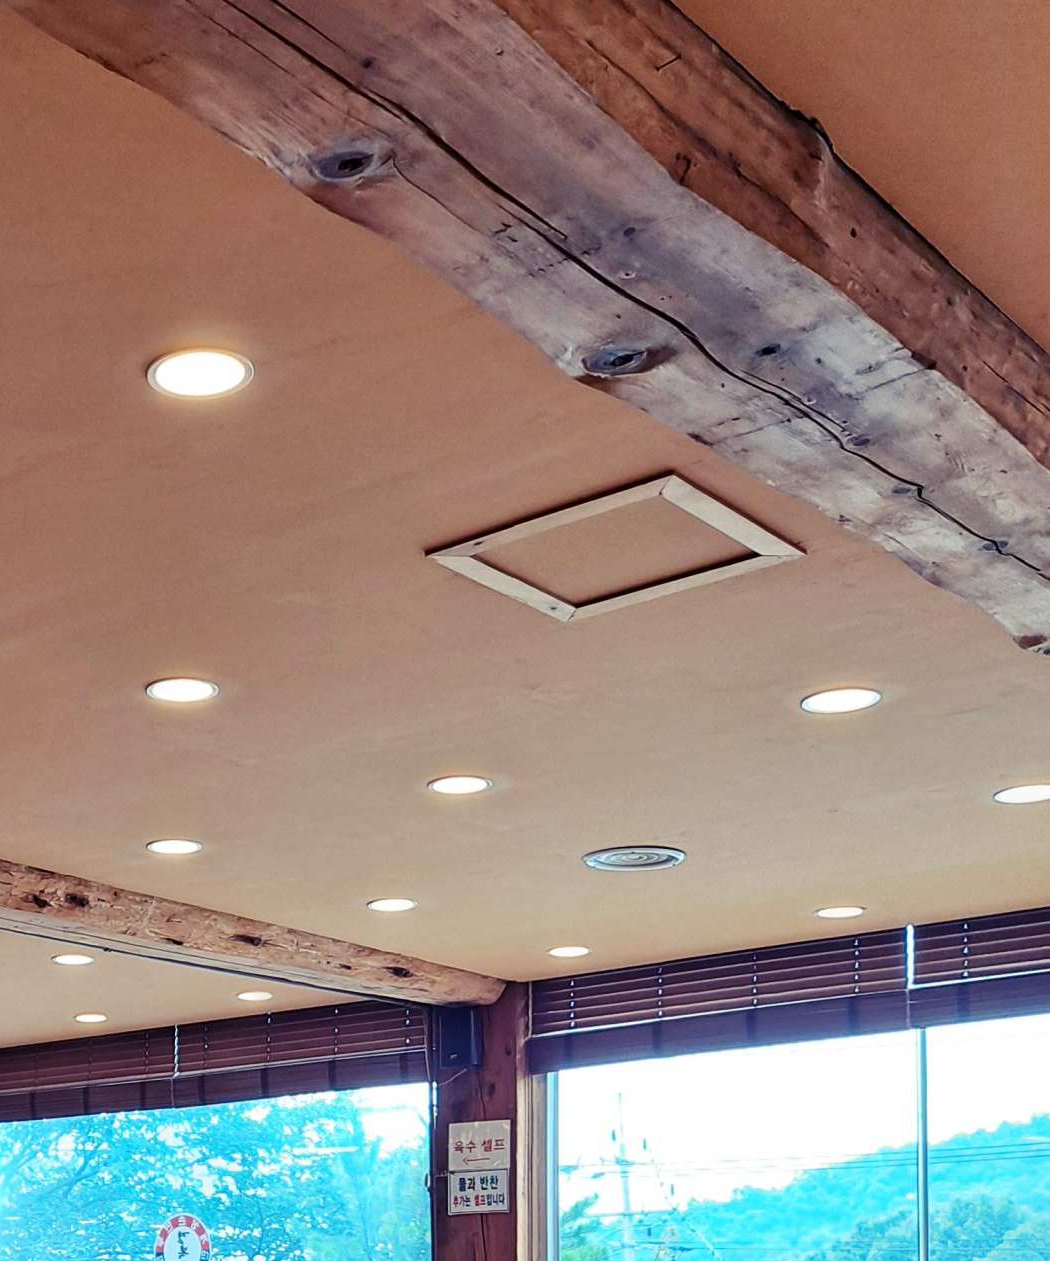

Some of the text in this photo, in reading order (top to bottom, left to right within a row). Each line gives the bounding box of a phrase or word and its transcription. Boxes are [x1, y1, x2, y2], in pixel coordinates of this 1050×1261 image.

[481, 1138, 506, 1153] 셀프
[479, 1175, 499, 1191] 반찬
[474, 1192, 505, 1207] 셀프입니다
